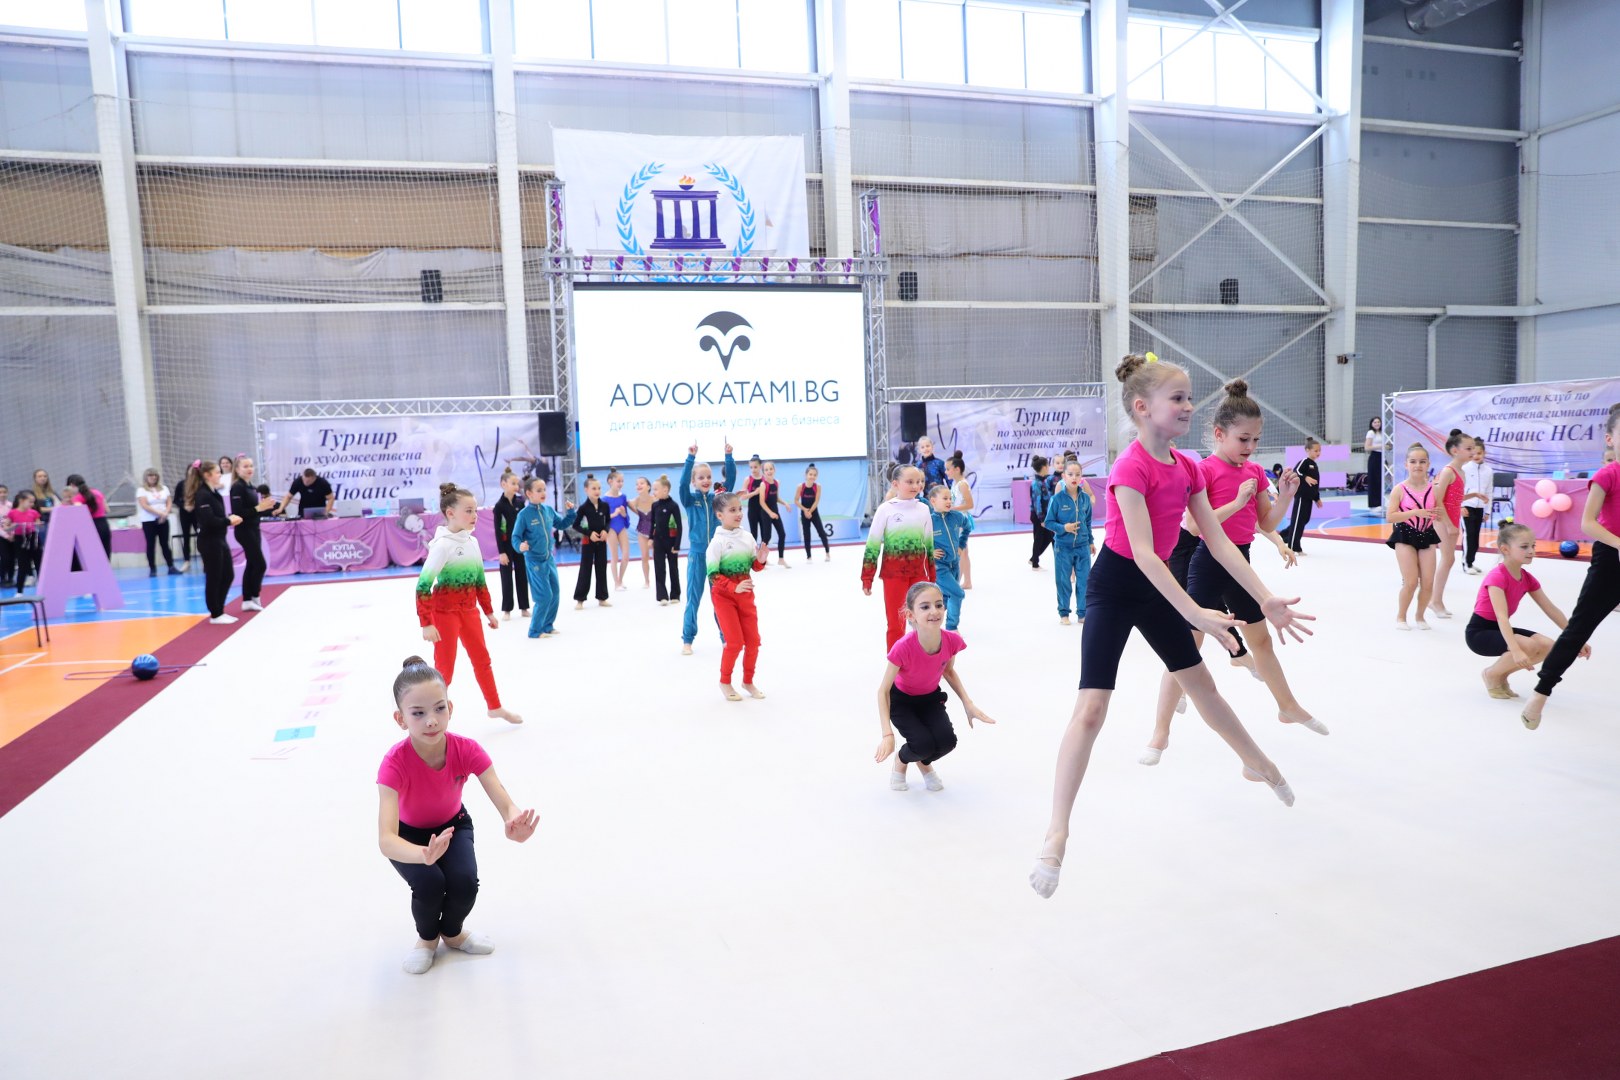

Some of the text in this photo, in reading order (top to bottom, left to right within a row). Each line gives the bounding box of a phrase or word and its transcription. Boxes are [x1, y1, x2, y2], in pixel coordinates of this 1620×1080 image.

[609, 380, 839, 407] ADVOKATAMI.BG
[1491, 390, 1590, 407] Спортен клуб по
[609, 414, 840, 432] дигитални правни услуги за бизнеса
[1015, 407, 1070, 427] Турнир
[1463, 410, 1543, 424] художествена
[318, 428, 398, 451] Турнир
[997, 427, 1087, 439] по художествена
[1487, 427, 1545, 443] Нюанс
[990, 440, 1093, 451] гимнастика за купа
[293, 451, 422, 467] по художествена
[285, 465, 432, 481] гиастика за купа
[824, 523, 835, 537] 3
[323, 550, 363, 560] НЮАНС
[332, 543, 355, 551] КУПА
